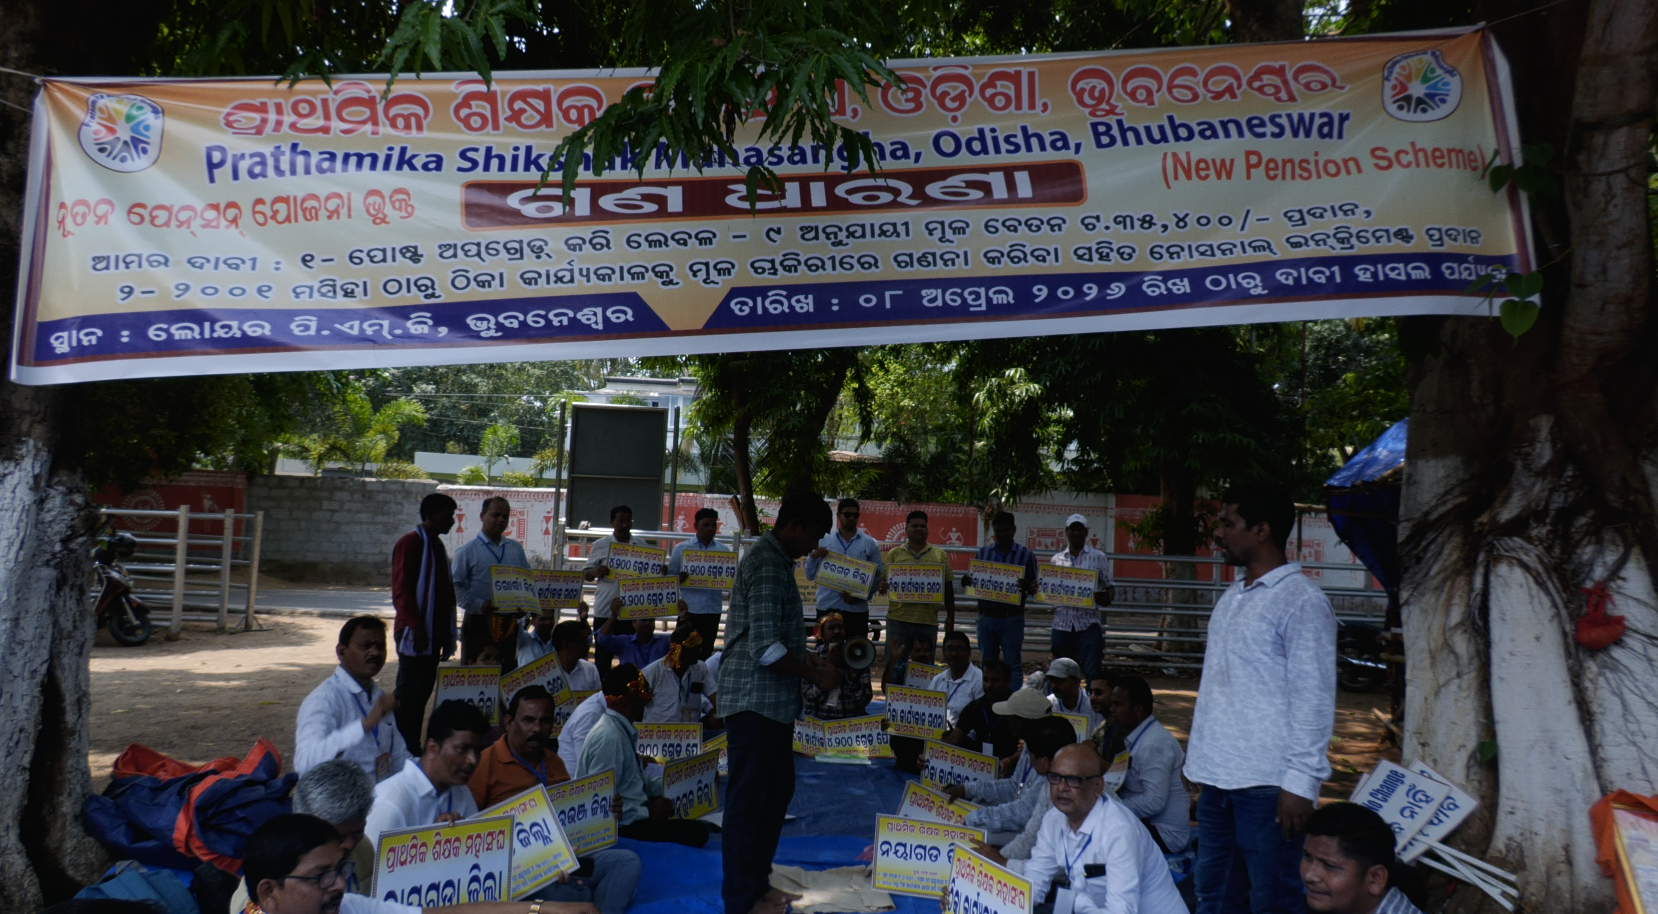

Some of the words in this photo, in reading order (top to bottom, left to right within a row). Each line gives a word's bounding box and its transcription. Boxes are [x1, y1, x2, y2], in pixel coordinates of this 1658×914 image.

[222, 82, 431, 136] ପ୍ରାଥମିକ
[206, 142, 444, 184] Prathamika
[934, 123, 1082, 157] Odisha,
[1093, 111, 1351, 149] Bhubaneswar
[1162, 151, 1233, 190] (New
[1246, 151, 1361, 181] Pension
[507, 183, 683, 218] ଗଣ
[725, 171, 1034, 212] ଧାରଣା
[91, 252, 170, 271] ଆମର
[187, 255, 258, 271] ଦାବୀ
[564, 229, 612, 252] କରି
[626, 229, 717, 249] ଲେବଳ
[799, 221, 910, 246] ଅନୁଯାୟୀ
[925, 217, 970, 243] ମୂଳ
[984, 215, 1066, 235] ବେତନ
[1283, 202, 1372, 227] ପ୍ରଦାନ,
[174, 283, 273, 299] ୨୦୦୧
[292, 277, 368, 299] ମସିହା
[384, 275, 442, 298] ଠାରୁ
[451, 269, 504, 291] ଠିକା
[688, 260, 737, 284] ମୂଳ
[893, 250, 970, 271] ଗଣନା
[983, 243, 1059, 265] କରିବା
[1073, 240, 1136, 262] ସହିତ
[1425, 227, 1482, 248] ପ୍ରଦାନ
[729, 290, 814, 317] ତାରିଖ
[1032, 280, 1126, 304] ୨୦୨୬
[1142, 275, 1192, 297] ରିଖ
[1205, 271, 1269, 296] ଠାରୁ
[1275, 265, 1341, 287] ଦାବୀ
[1354, 262, 1432, 284] ହାସଲ
[49, 328, 104, 355] ସ୍ଥାନ
[148, 320, 271, 342] ଲୋୟର
[1369, 769, 1407, 804] Change
[386, 834, 428, 873] ପ୍ରାଥମିକ
[432, 831, 462, 861] ଶିକ୍ଷକ
